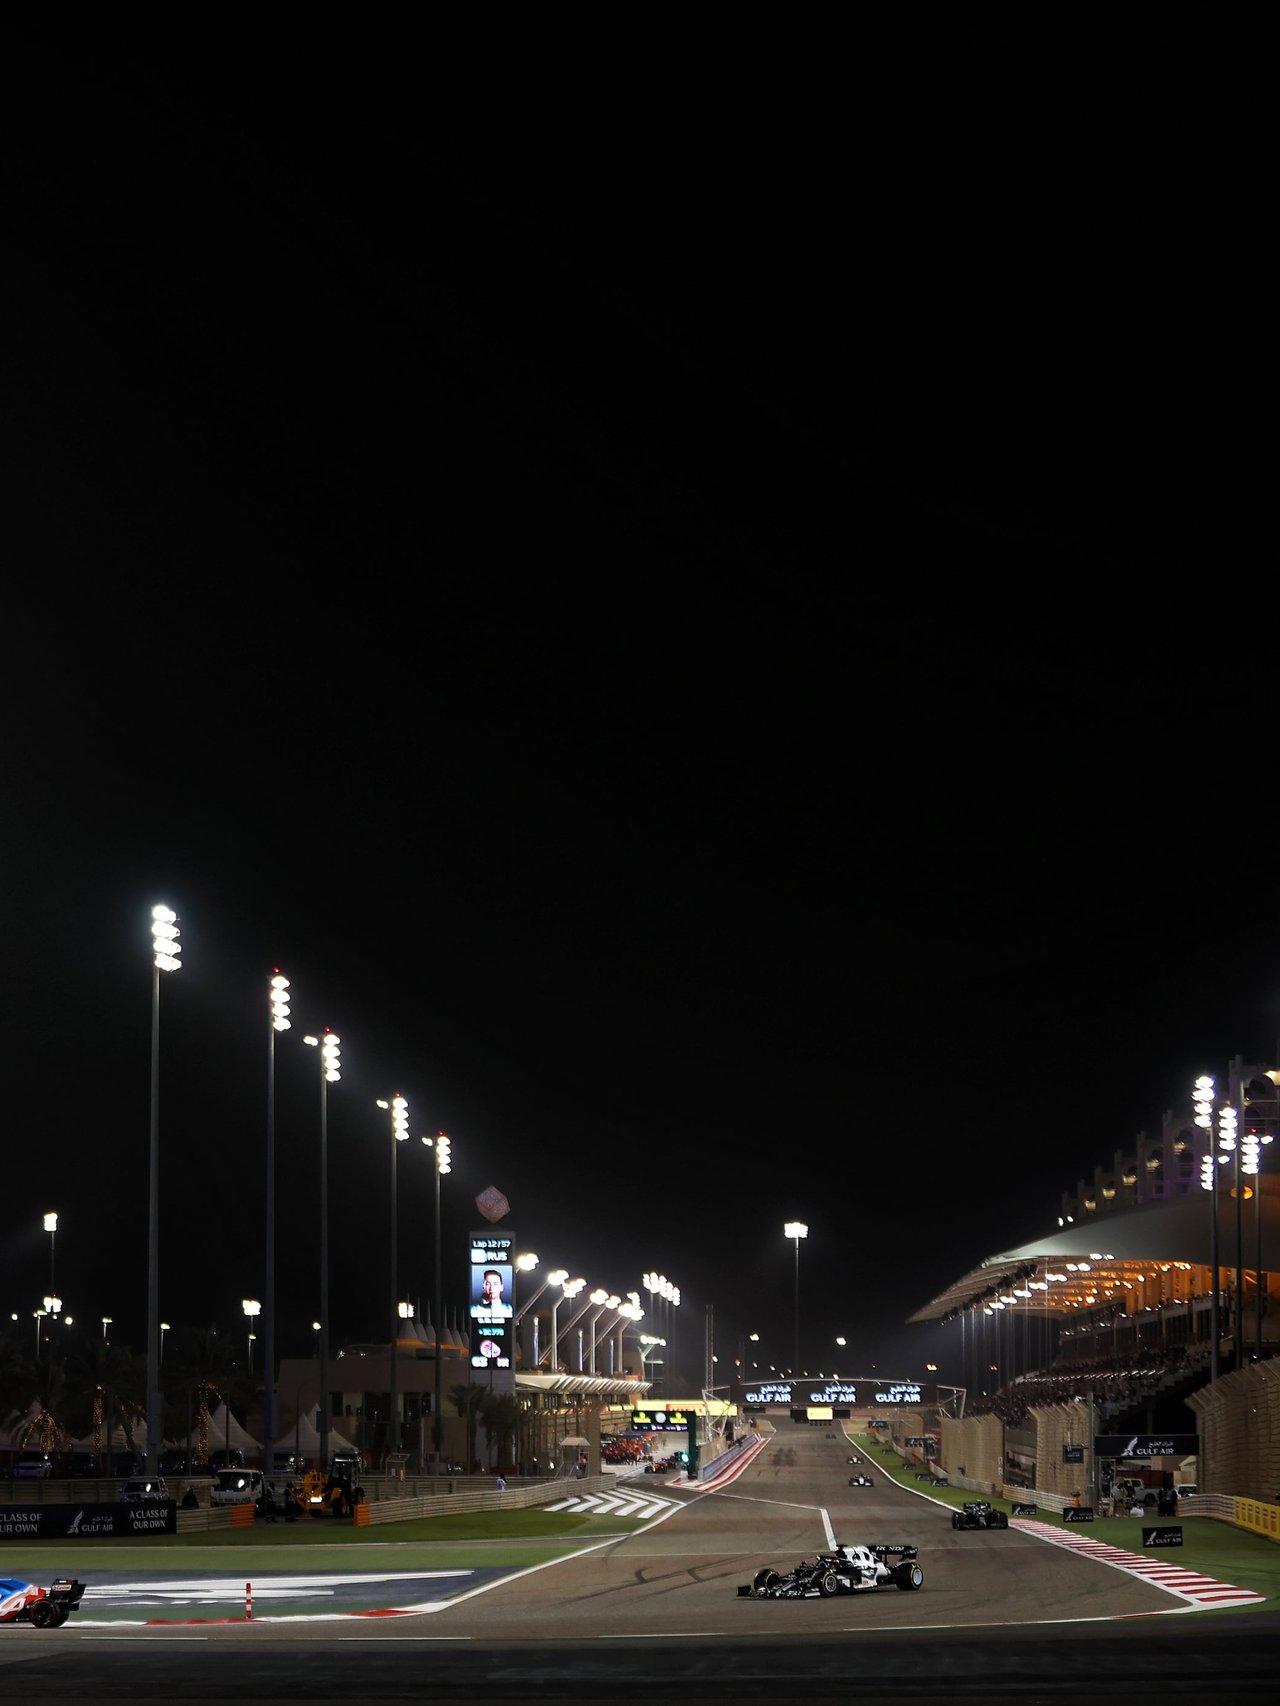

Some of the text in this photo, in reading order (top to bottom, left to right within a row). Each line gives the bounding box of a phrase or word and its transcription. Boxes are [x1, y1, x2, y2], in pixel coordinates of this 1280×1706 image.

[473, 1240, 487, 1248] Lap
[487, 1252, 507, 1261] RUS
[746, 1393, 792, 1402] GULF AIR
[810, 1393, 856, 1402] GULF AIR
[875, 1393, 921, 1402] GULF AIR
[31, 1512, 42, 1521] OF
[130, 1511, 136, 1519] A
[158, 1510, 169, 1518] OF
[16, 1524, 39, 1533] OWN
[82, 1523, 113, 1532] GULF AIR
[133, 1520, 165, 1529] OUR OWN
